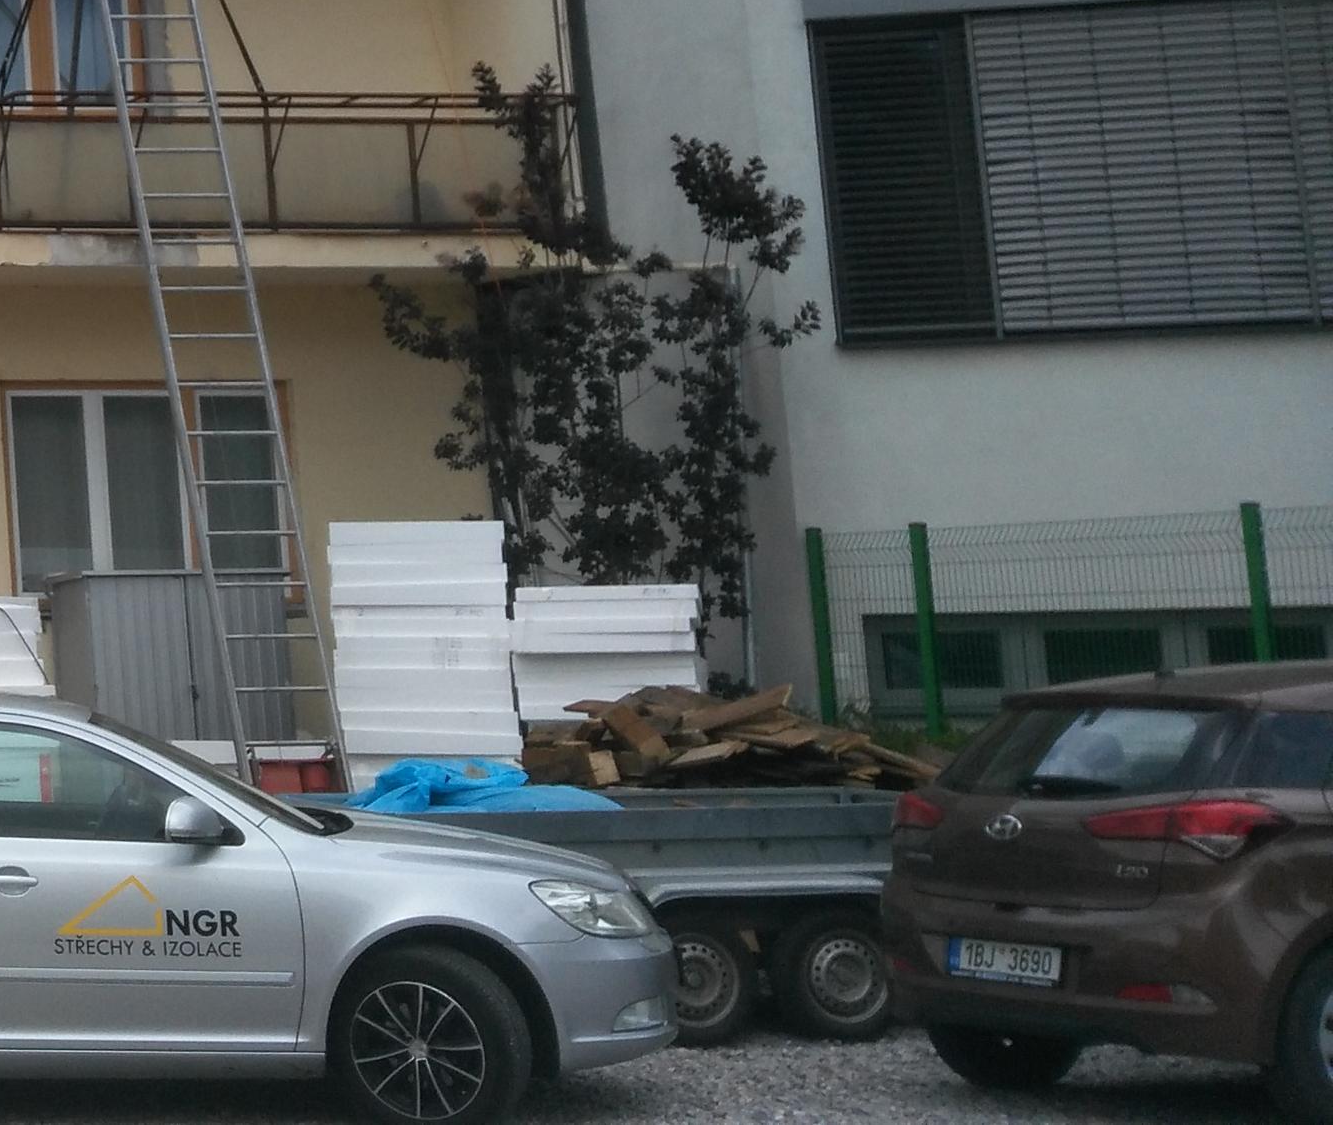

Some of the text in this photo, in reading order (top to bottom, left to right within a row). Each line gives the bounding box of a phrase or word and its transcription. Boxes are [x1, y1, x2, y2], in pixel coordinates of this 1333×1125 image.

[165, 909, 240, 937] NGR
[53, 935, 242, 958] STŘECHY & IZOLACE
[966, 943, 1053, 974] 1BJ 3690
